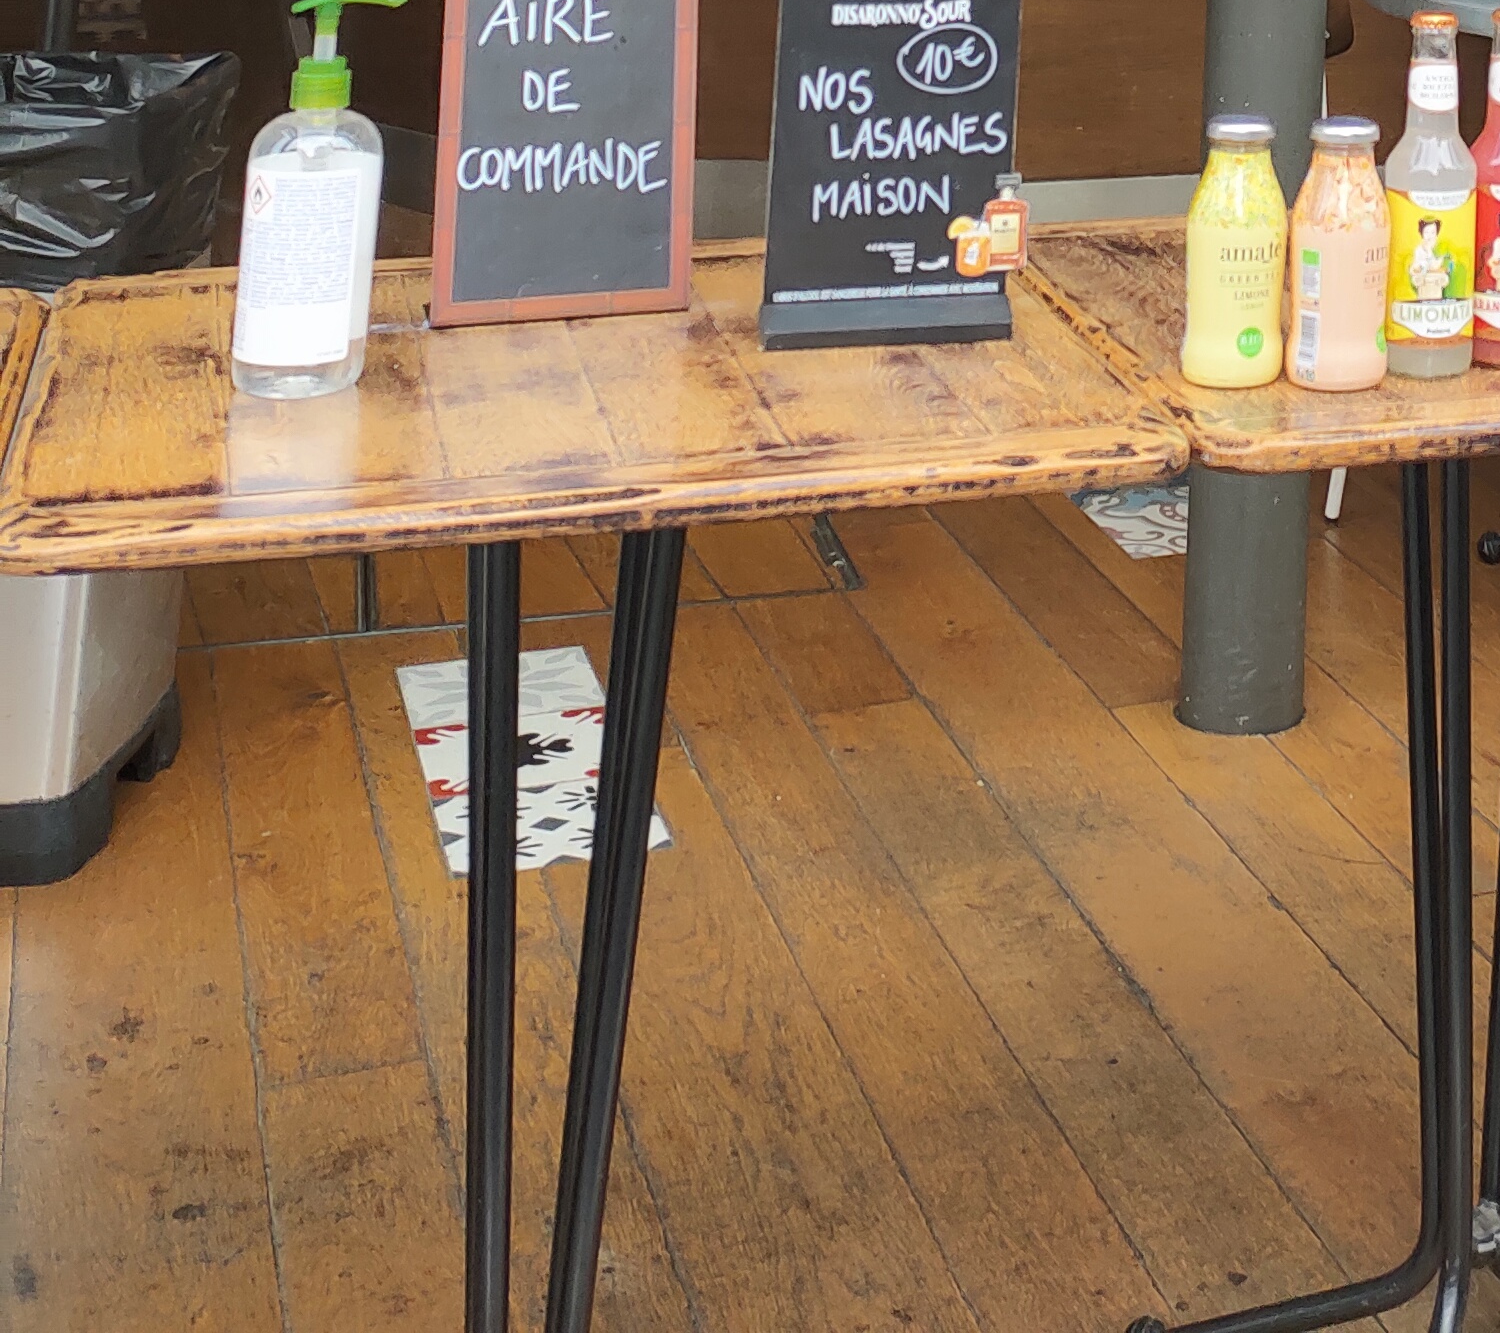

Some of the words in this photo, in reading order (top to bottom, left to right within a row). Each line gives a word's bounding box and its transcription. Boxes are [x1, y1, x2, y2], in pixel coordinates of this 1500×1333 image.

[831, 2, 923, 27] DISARONNO
[914, 35, 986, 85] 10€
[522, 68, 582, 113] DE
[798, 65, 875, 115] NOS
[828, 111, 1008, 161] LASAGNES
[456, 136, 669, 194] COMMANDE
